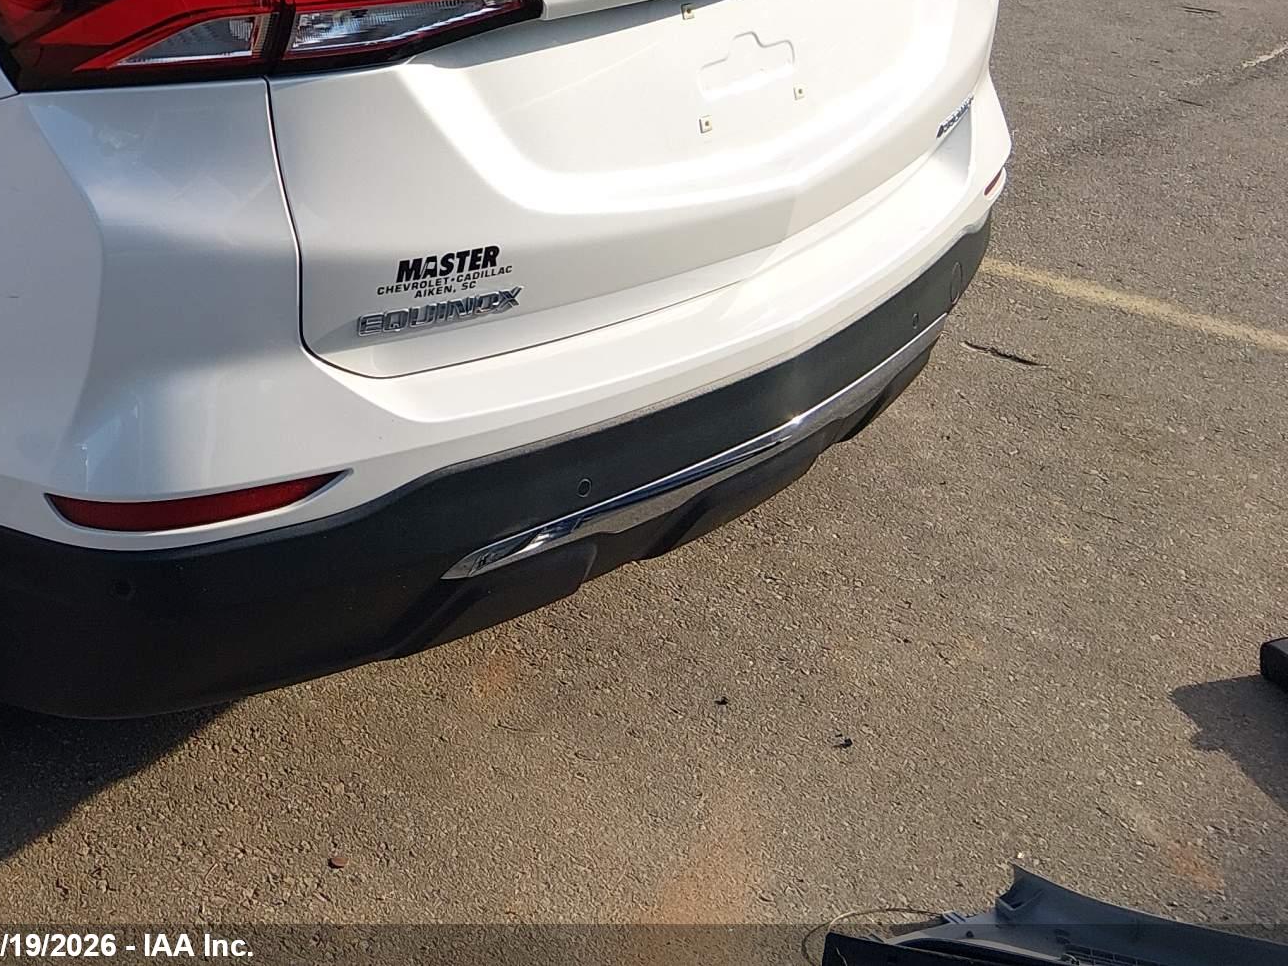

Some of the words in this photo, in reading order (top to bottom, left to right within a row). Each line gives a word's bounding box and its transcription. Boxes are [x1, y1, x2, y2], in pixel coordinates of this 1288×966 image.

[396, 245, 500, 283] MASTER
[414, 285, 456, 299] AIKEN,
[461, 280, 477, 291] SC
[357, 286, 523, 337] EQUINOX
